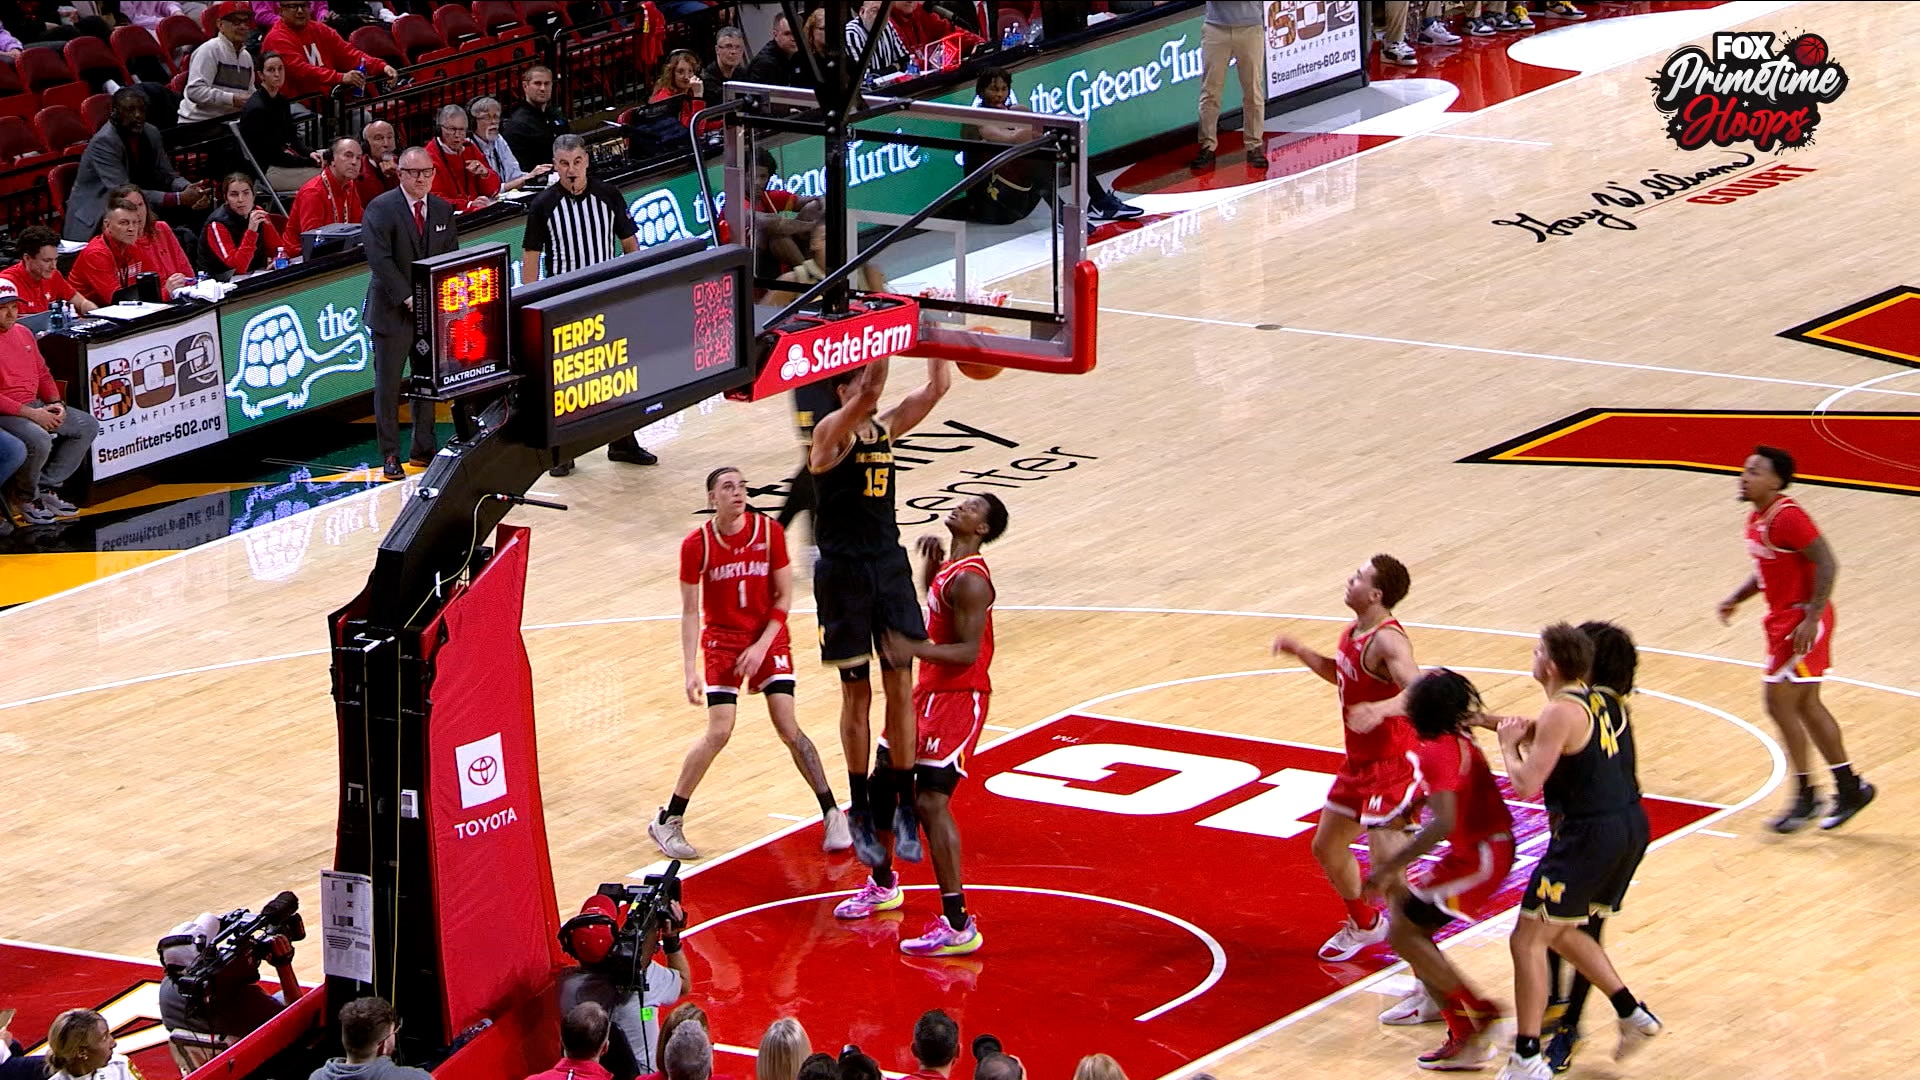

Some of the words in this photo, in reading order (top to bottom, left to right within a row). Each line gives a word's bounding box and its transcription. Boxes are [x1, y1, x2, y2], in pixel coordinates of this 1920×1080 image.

[1271, 49, 1357, 84] Steamfitters-602.org
[1029, 83, 1064, 114] the
[1066, 69, 1163, 121] Greene
[1685, 164, 1819, 205] COURT
[316, 302, 360, 342] the
[552, 313, 607, 355] TERPS
[91, 331, 219, 421] 602
[443, 363, 497, 386] DAKTRONICS
[552, 337, 629, 386] RESERVE
[554, 366, 639, 417] BOURBON
[98, 415, 221, 463] Steamfitters-602.org
[863, 467, 889, 497] 15
[709, 560, 770, 582] MARYLAND
[737, 579, 748, 609] 1
[773, 654, 790, 670] M
[925, 736, 941, 753] M
[1367, 794, 1384, 811] M
[453, 806, 518, 839] TOYOTA
[1536, 875, 1566, 904] M
